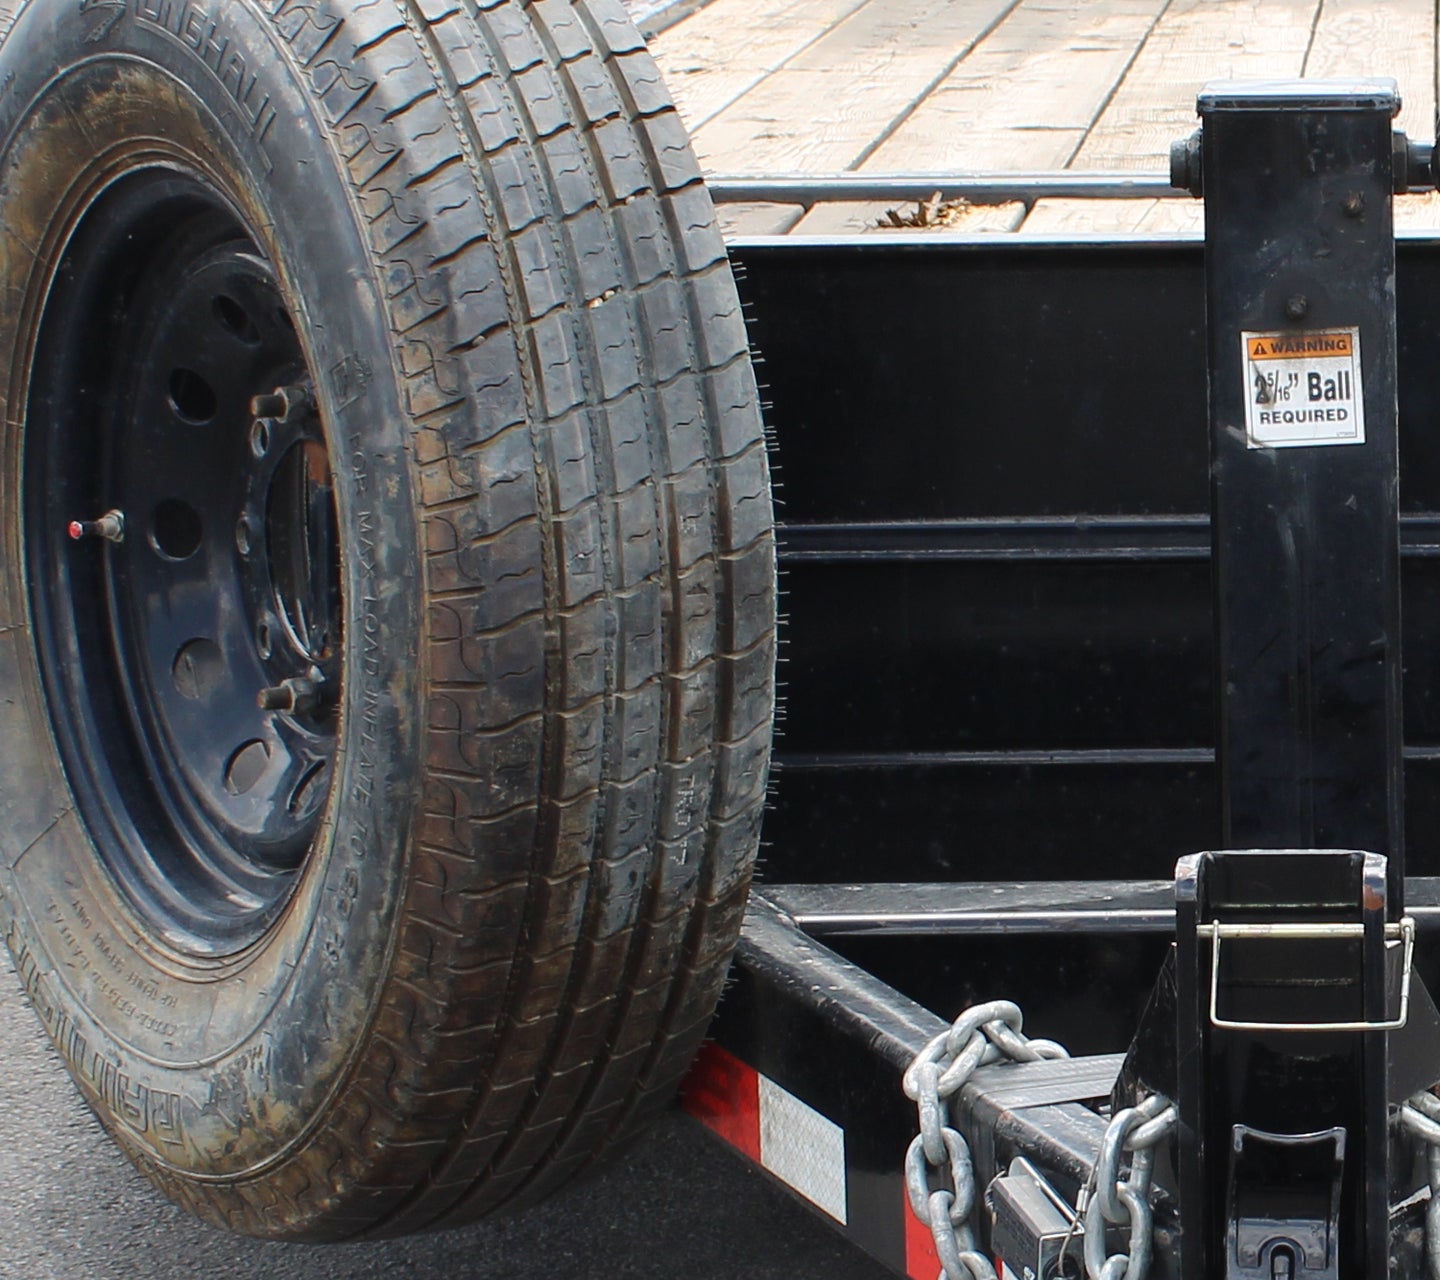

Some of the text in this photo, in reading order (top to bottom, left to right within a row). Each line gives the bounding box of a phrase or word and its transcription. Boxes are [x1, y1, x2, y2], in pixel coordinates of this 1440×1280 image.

[1270, 338, 1348, 354] WARNING
[1307, 370, 1352, 403] Ball
[1259, 408, 1349, 425] REQUIRED
[357, 510, 376, 578] MAX
[364, 596, 379, 677] LOAD
